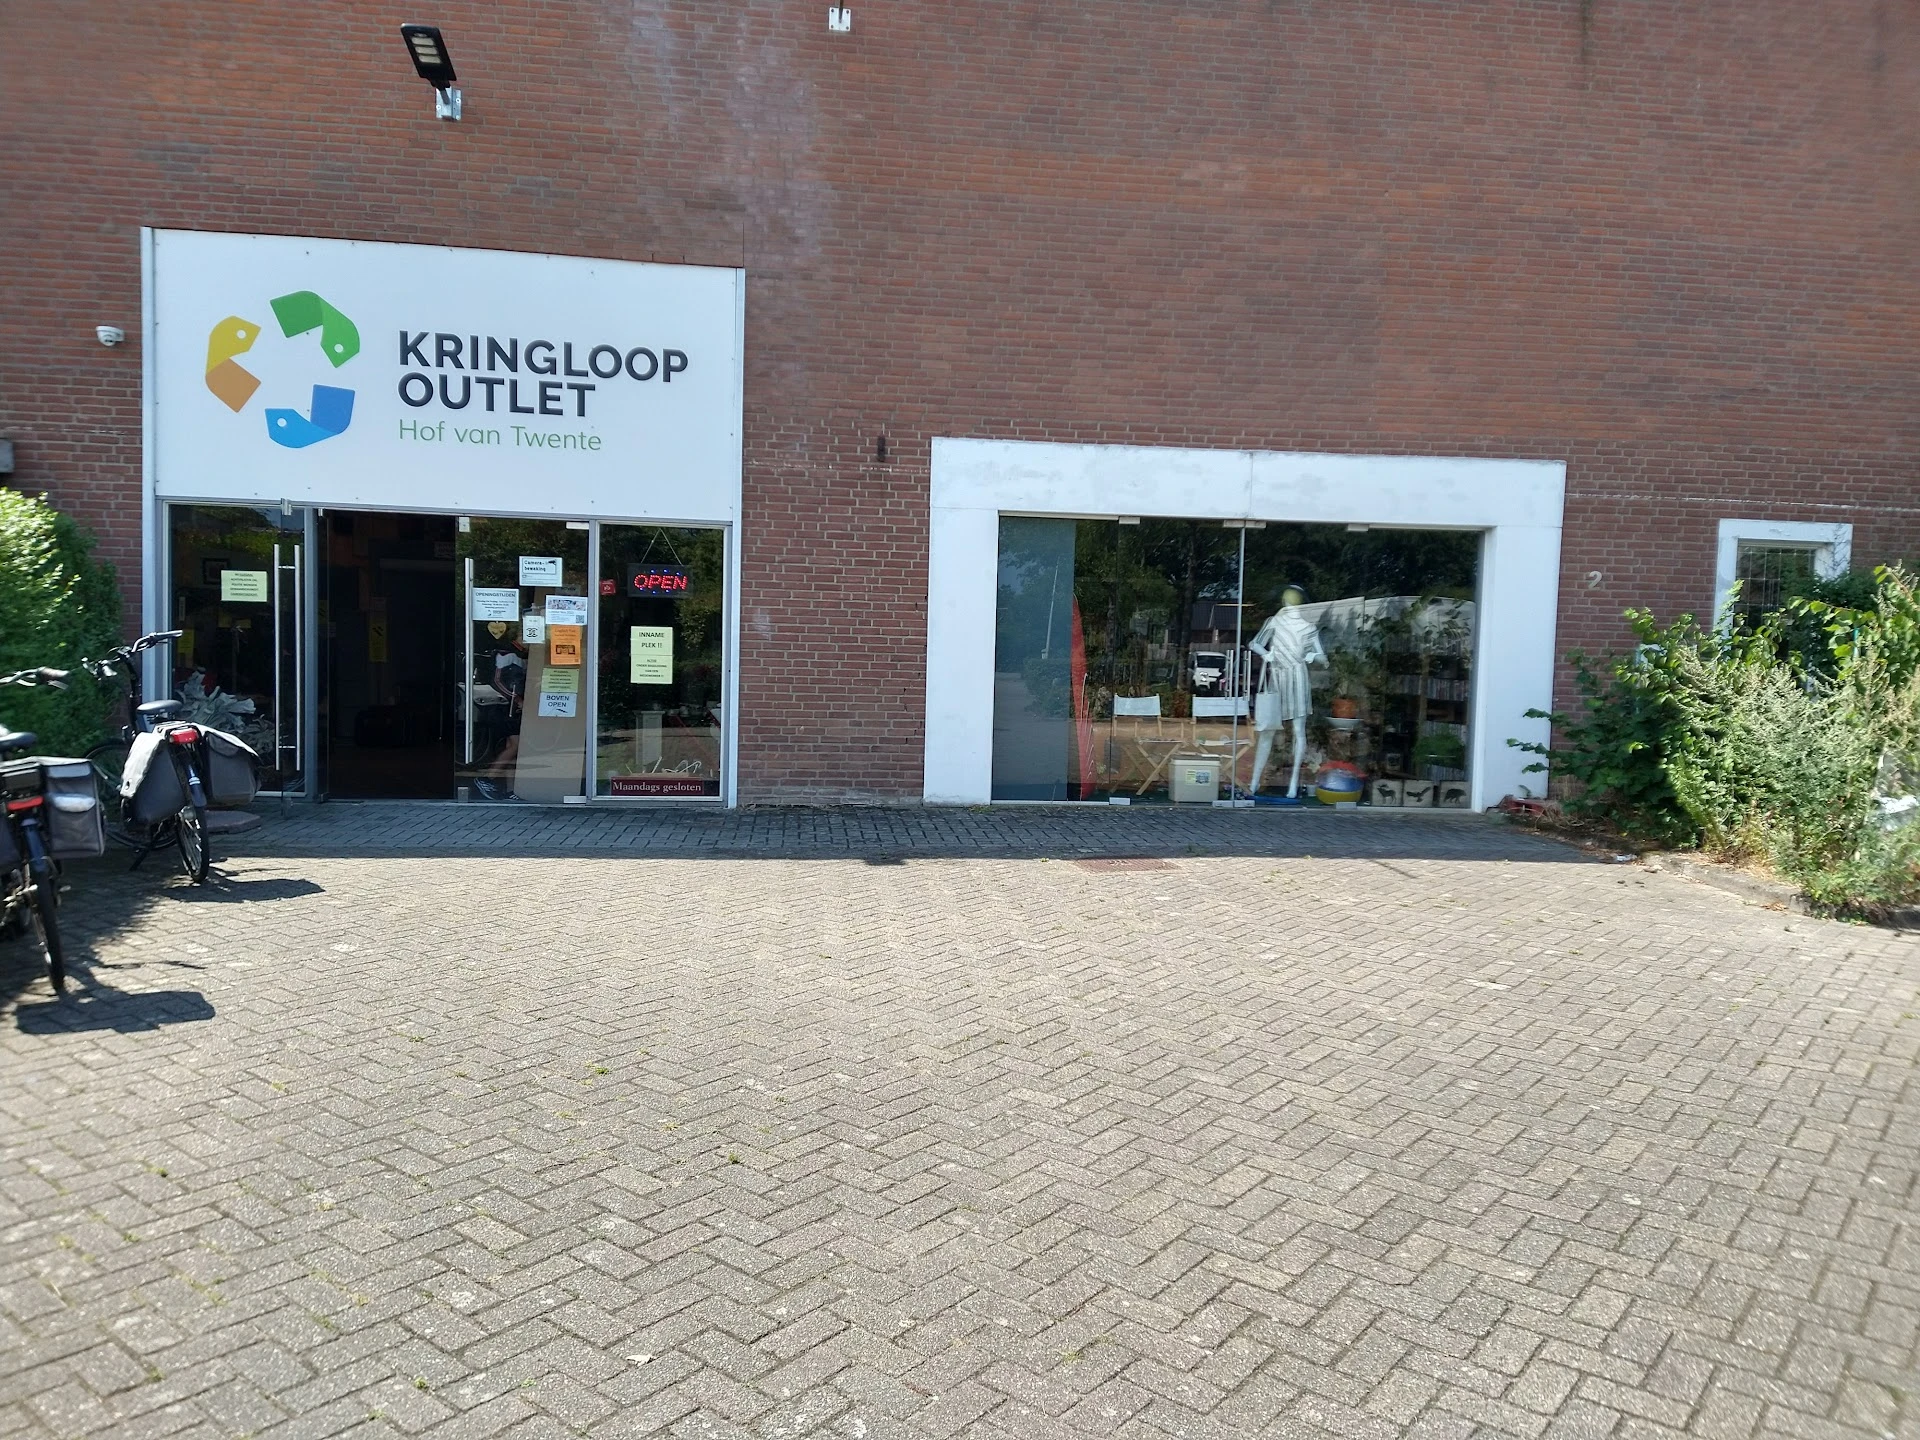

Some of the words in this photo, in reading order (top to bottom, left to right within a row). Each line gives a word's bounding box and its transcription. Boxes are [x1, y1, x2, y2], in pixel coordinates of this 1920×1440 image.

[399, 330, 689, 383] KRINGLOOP
[397, 371, 596, 417] OUTLET
[399, 418, 446, 442] Hof
[453, 426, 500, 445] van
[510, 425, 602, 451] Twente
[634, 574, 688, 590] OPEN
[1588, 570, 1602, 590] 2
[612, 781, 660, 793] Maandags
[662, 781, 702, 793] gesloten
